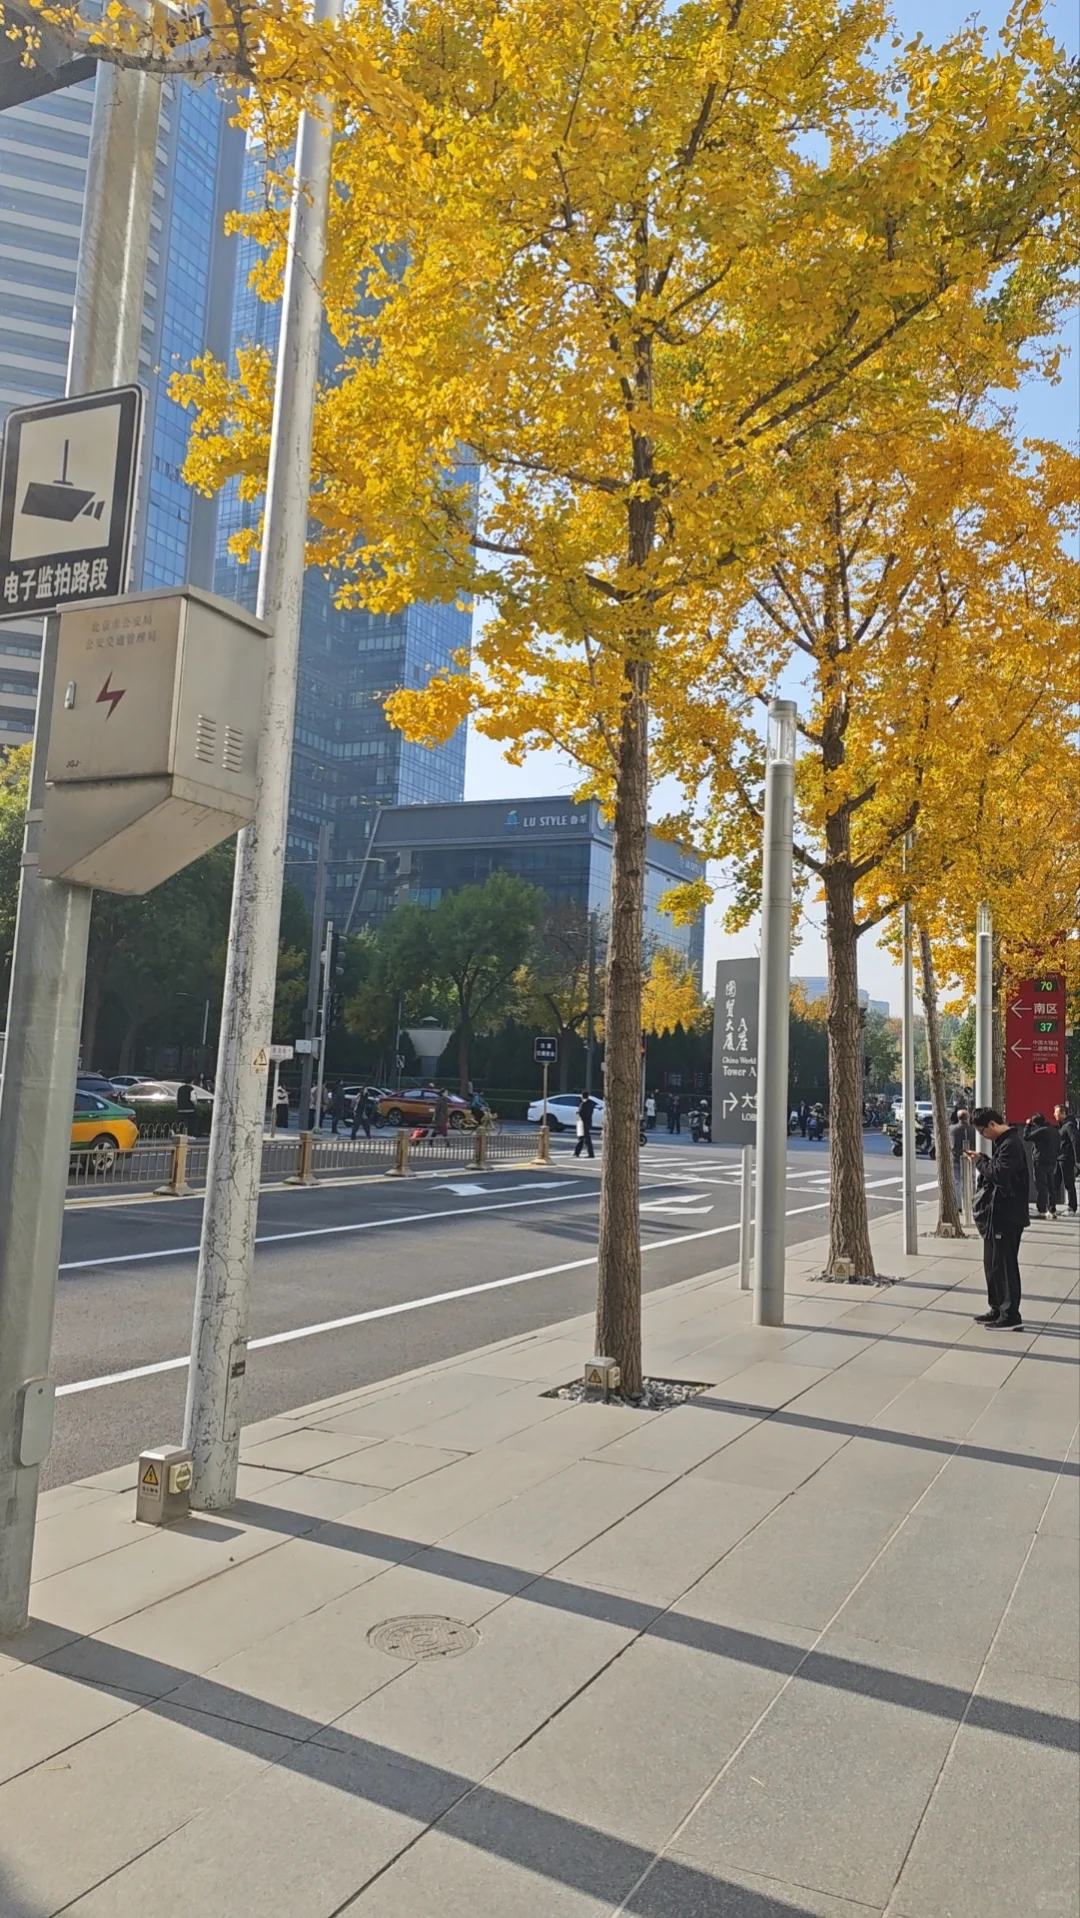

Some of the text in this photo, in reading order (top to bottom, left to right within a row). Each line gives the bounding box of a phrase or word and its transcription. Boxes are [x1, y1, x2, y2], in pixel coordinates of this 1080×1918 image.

[3, 558, 109, 603] 电子监拍路段
[523, 815, 568, 827] LU STYLE
[1040, 981, 1053, 991] 70
[1033, 1003, 1058, 1015] 南区
[1040, 1022, 1053, 1032] 37
[722, 1056, 757, 1065] China World
[722, 1065, 757, 1077] Tower A
